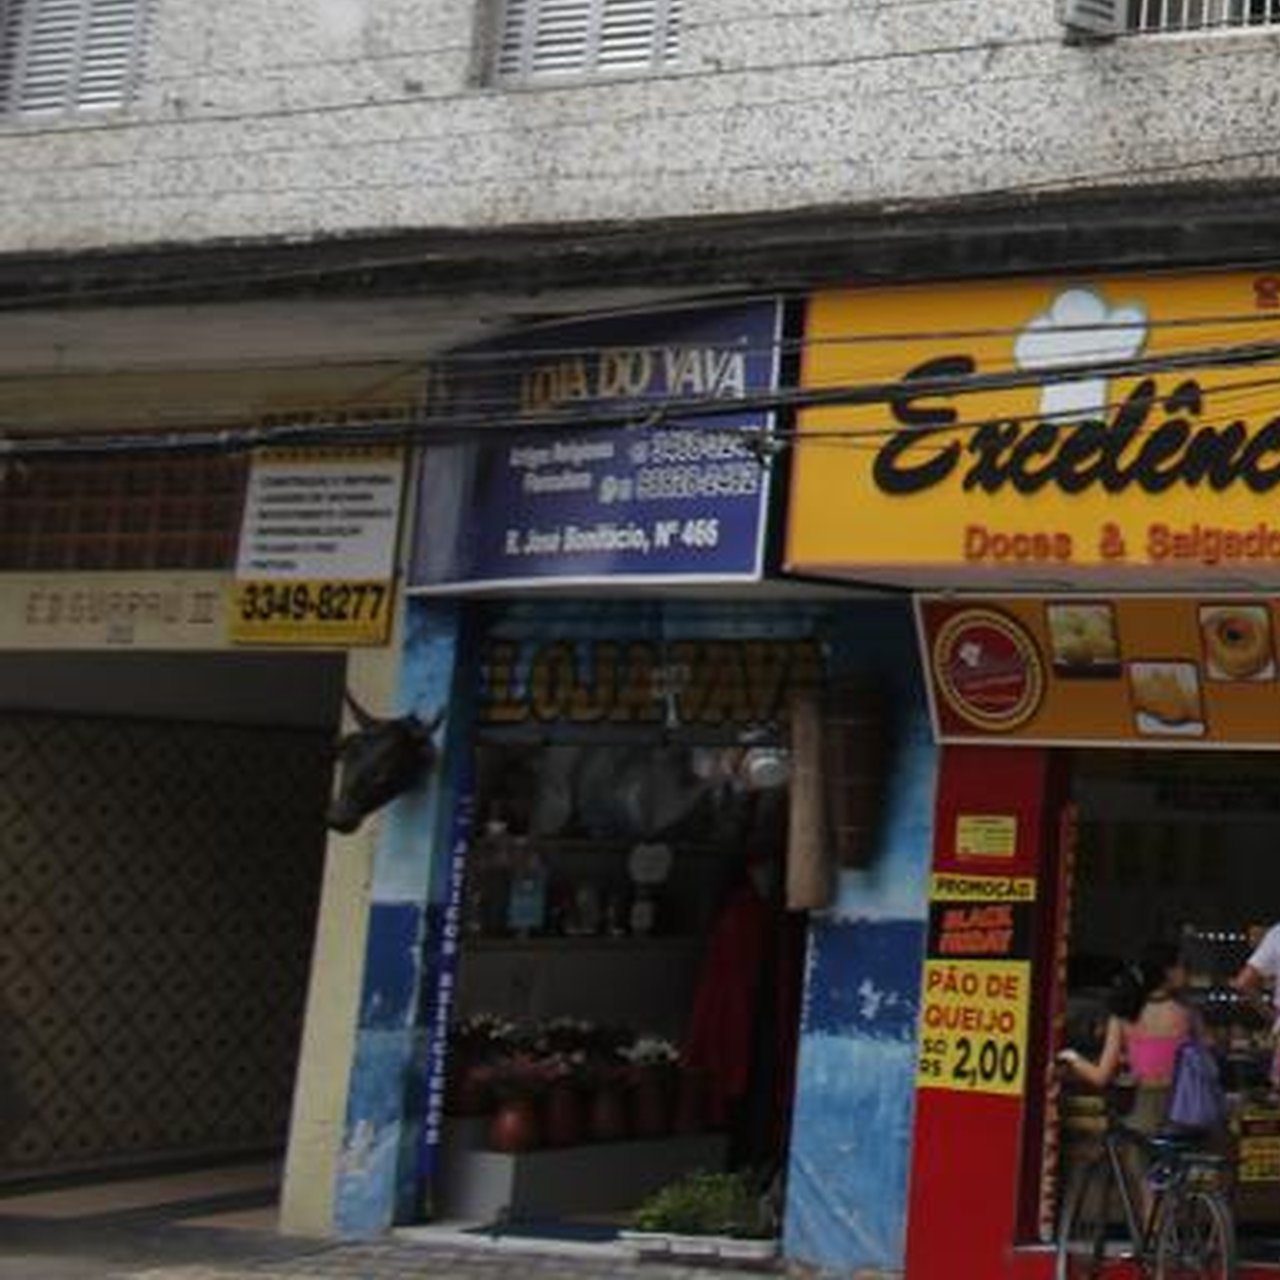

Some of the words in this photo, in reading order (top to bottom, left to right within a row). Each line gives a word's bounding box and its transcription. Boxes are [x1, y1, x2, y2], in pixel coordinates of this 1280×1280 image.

[601, 346, 651, 397] DO
[1100, 520, 1126, 560] &
[241, 582, 385, 621] 3349-8277
[927, 966, 979, 995] PÃO
[986, 974, 1019, 1000] DE
[924, 1004, 1016, 1034] QUEIJO
[952, 1037, 1020, 1087] 2,00
